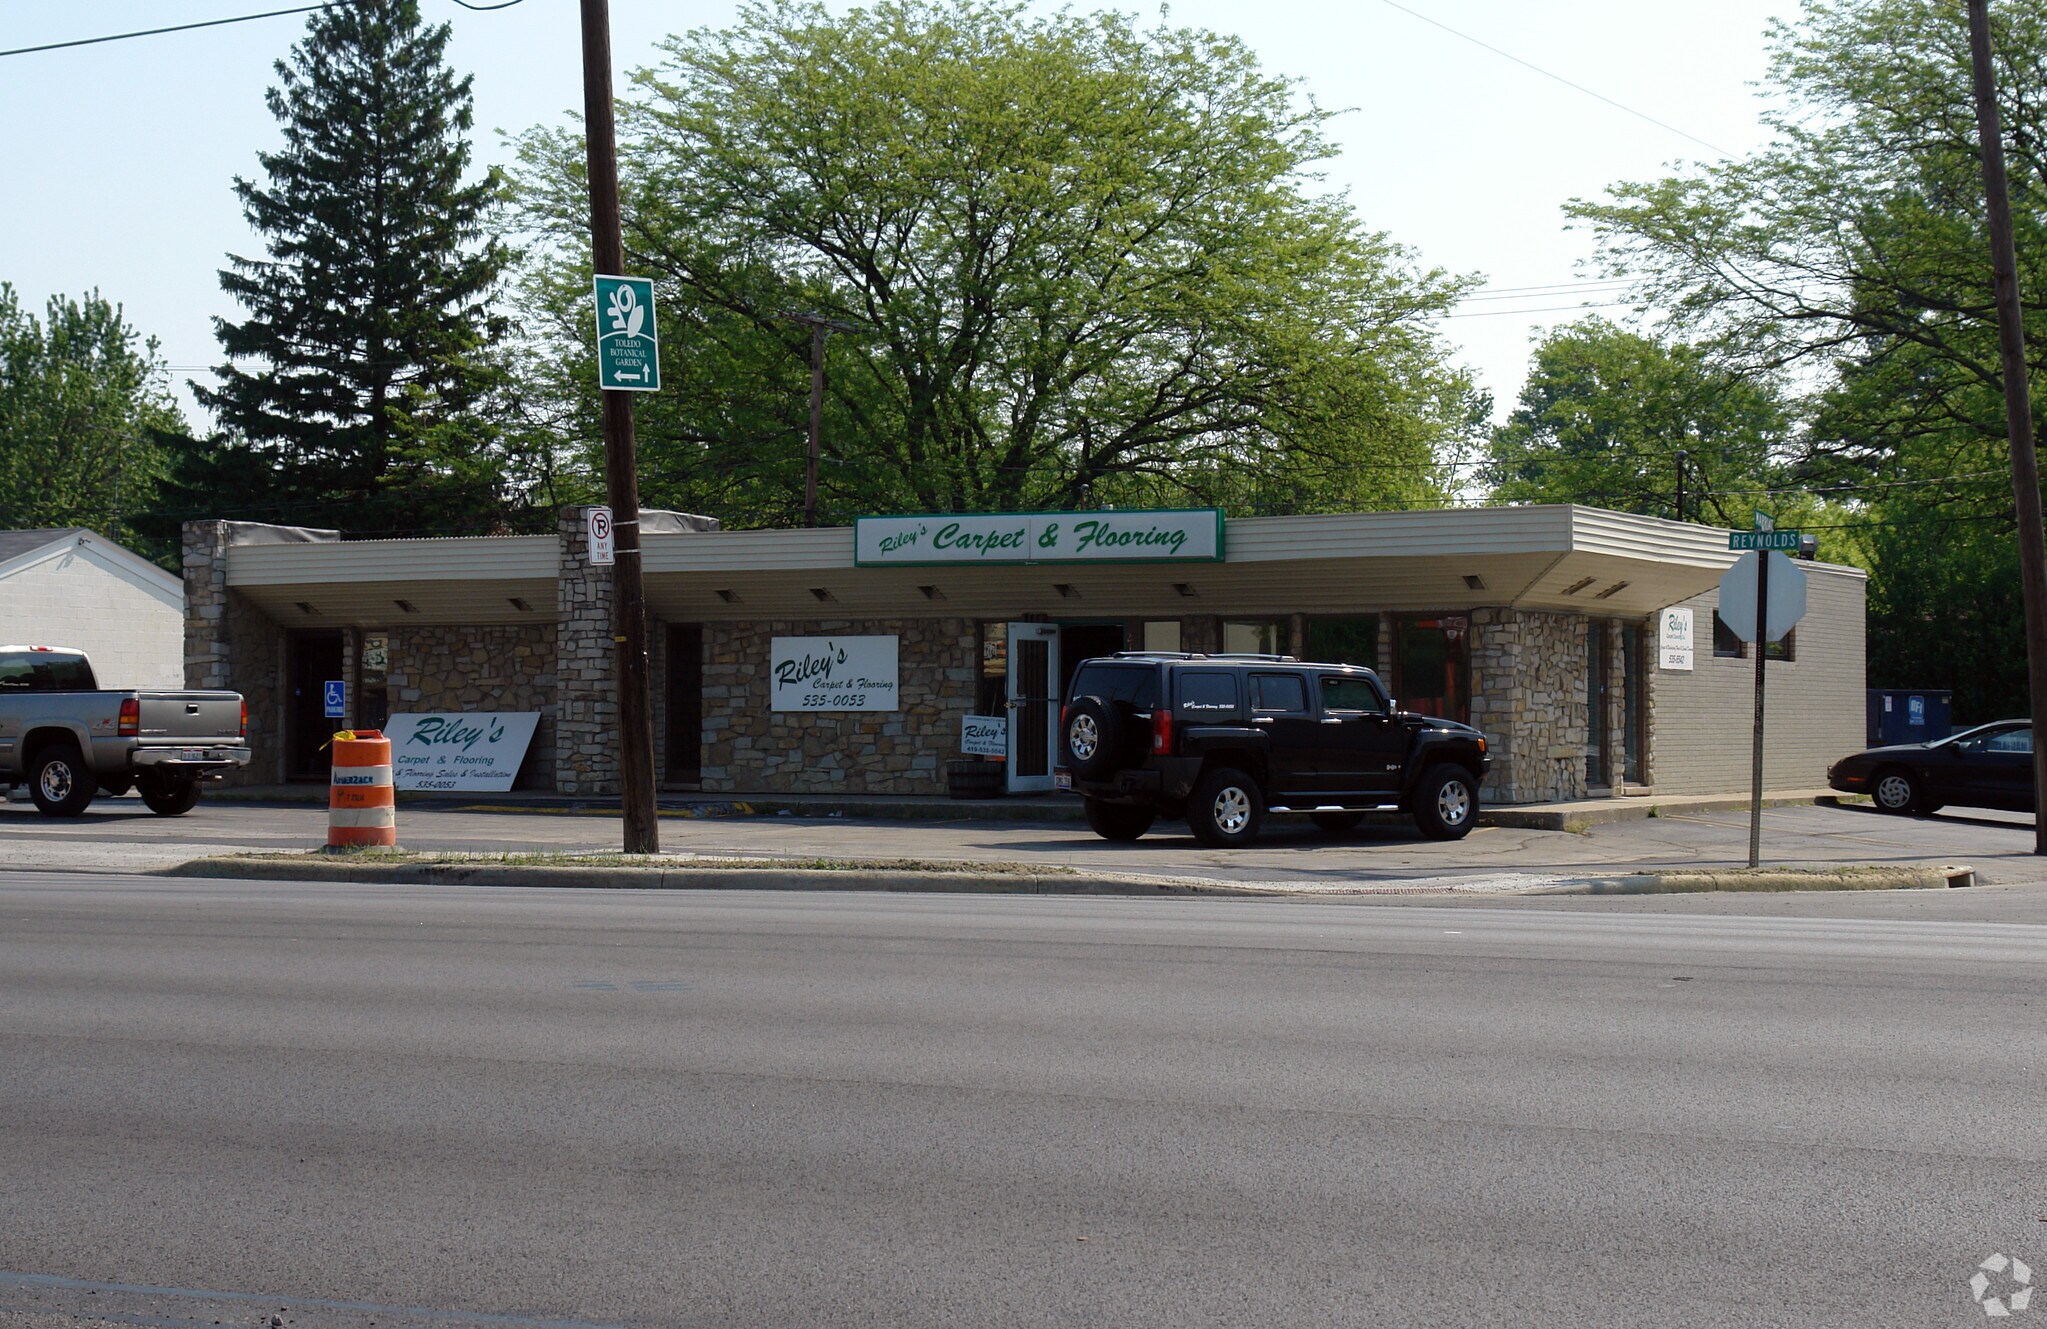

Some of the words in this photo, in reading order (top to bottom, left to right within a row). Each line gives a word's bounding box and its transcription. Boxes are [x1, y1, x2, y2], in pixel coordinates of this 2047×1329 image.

[614, 339, 641, 348] TOLEDO
[610, 348, 647, 358] BOTANICAL
[615, 358, 642, 367] GARDEN
[878, 523, 928, 556] Riley's
[933, 523, 1026, 556] Carpet
[1038, 523, 1059, 548] &
[1073, 520, 1188, 555] Flooring
[1732, 533, 1796, 548] REYNOLDS
[597, 542, 607, 550] ANY
[597, 551, 608, 560] TIME
[775, 641, 848, 692] Riley's
[812, 677, 843, 691] Carpet
[846, 678, 853, 688] &
[857, 678, 893, 692] Flooring
[802, 694, 866, 707] 535-0053
[406, 716, 505, 752] Riley's
[964, 723, 1006, 740] Riley's
[397, 755, 430, 766] Carpet
[437, 755, 446, 764] &
[453, 755, 494, 766] Flooring
[402, 768, 434, 778] Flooring
[436, 769, 459, 778] Sales
[469, 769, 512, 778] Installation
[415, 780, 457, 789] 535-0053
